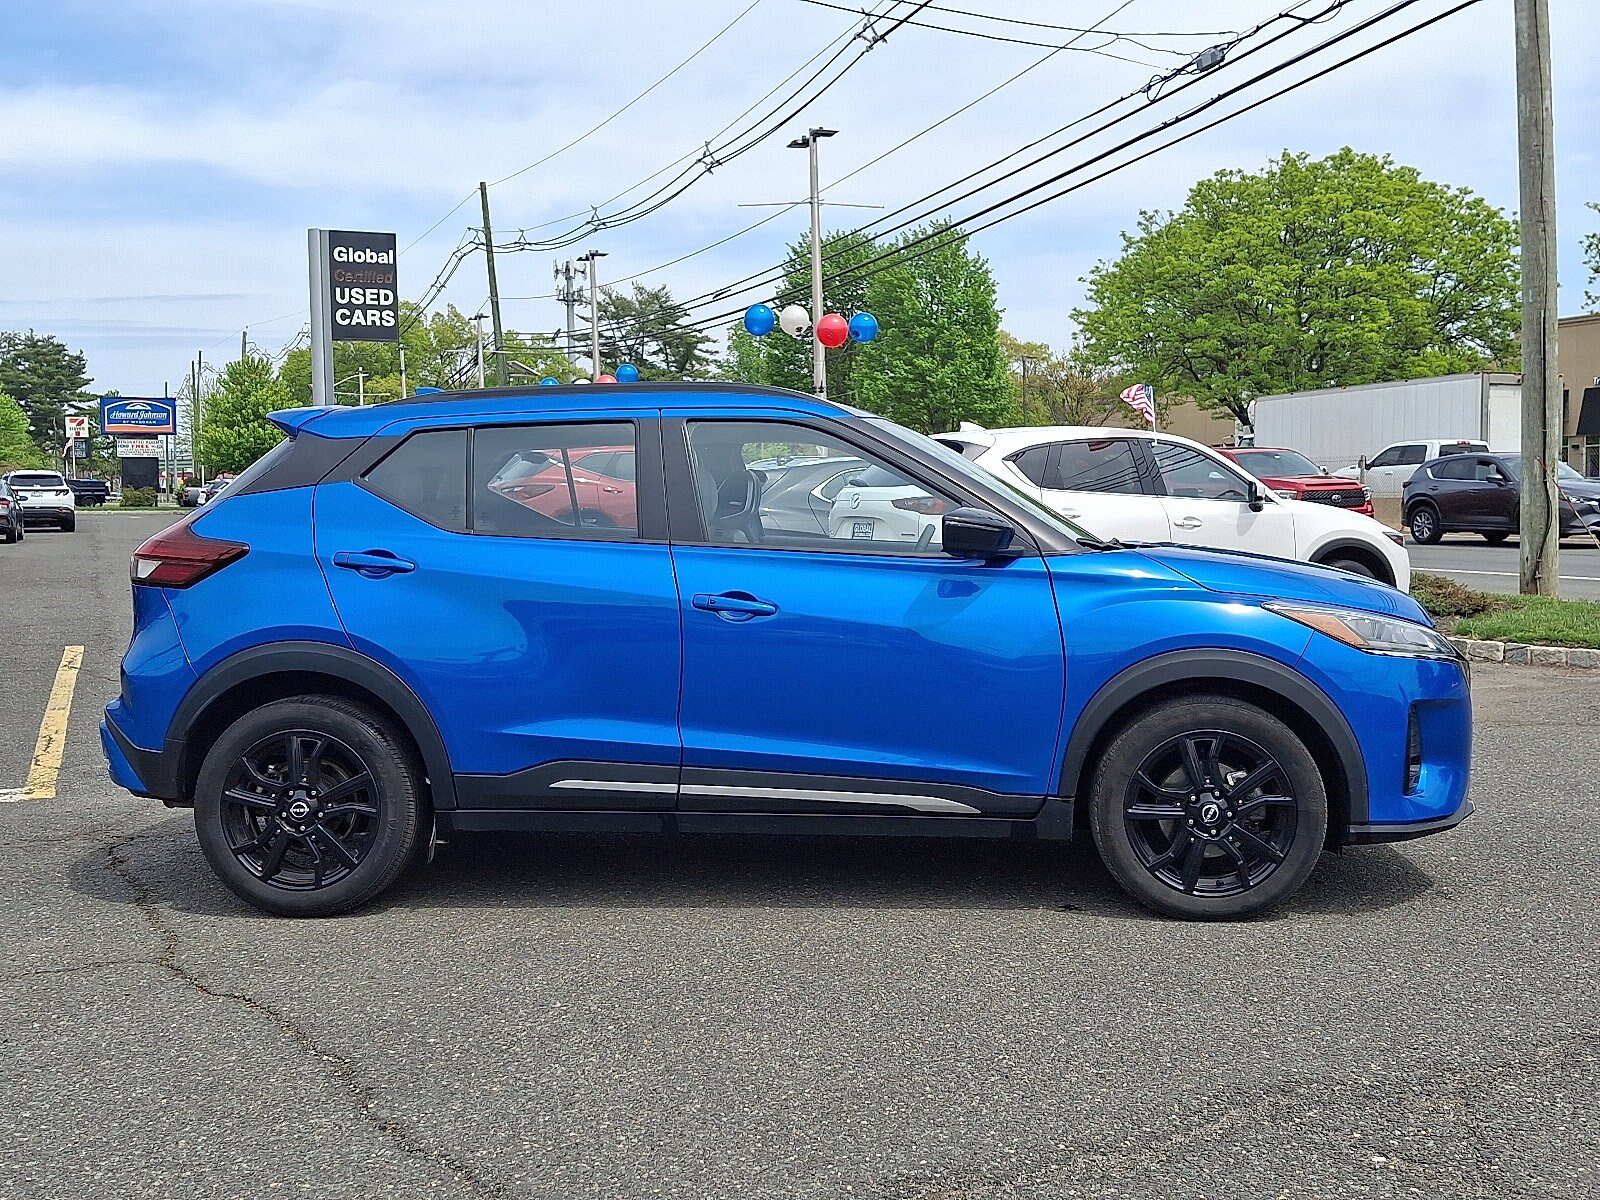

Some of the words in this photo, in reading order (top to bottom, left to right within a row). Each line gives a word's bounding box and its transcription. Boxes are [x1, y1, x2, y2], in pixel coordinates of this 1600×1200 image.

[333, 246, 394, 265] Global
[334, 269, 394, 284] Certified
[335, 287, 394, 306] USED
[335, 308, 396, 327] CARS
[69, 418, 85, 426] 7
[110, 411, 139, 420] Howard
[138, 411, 168, 421] Johnson
